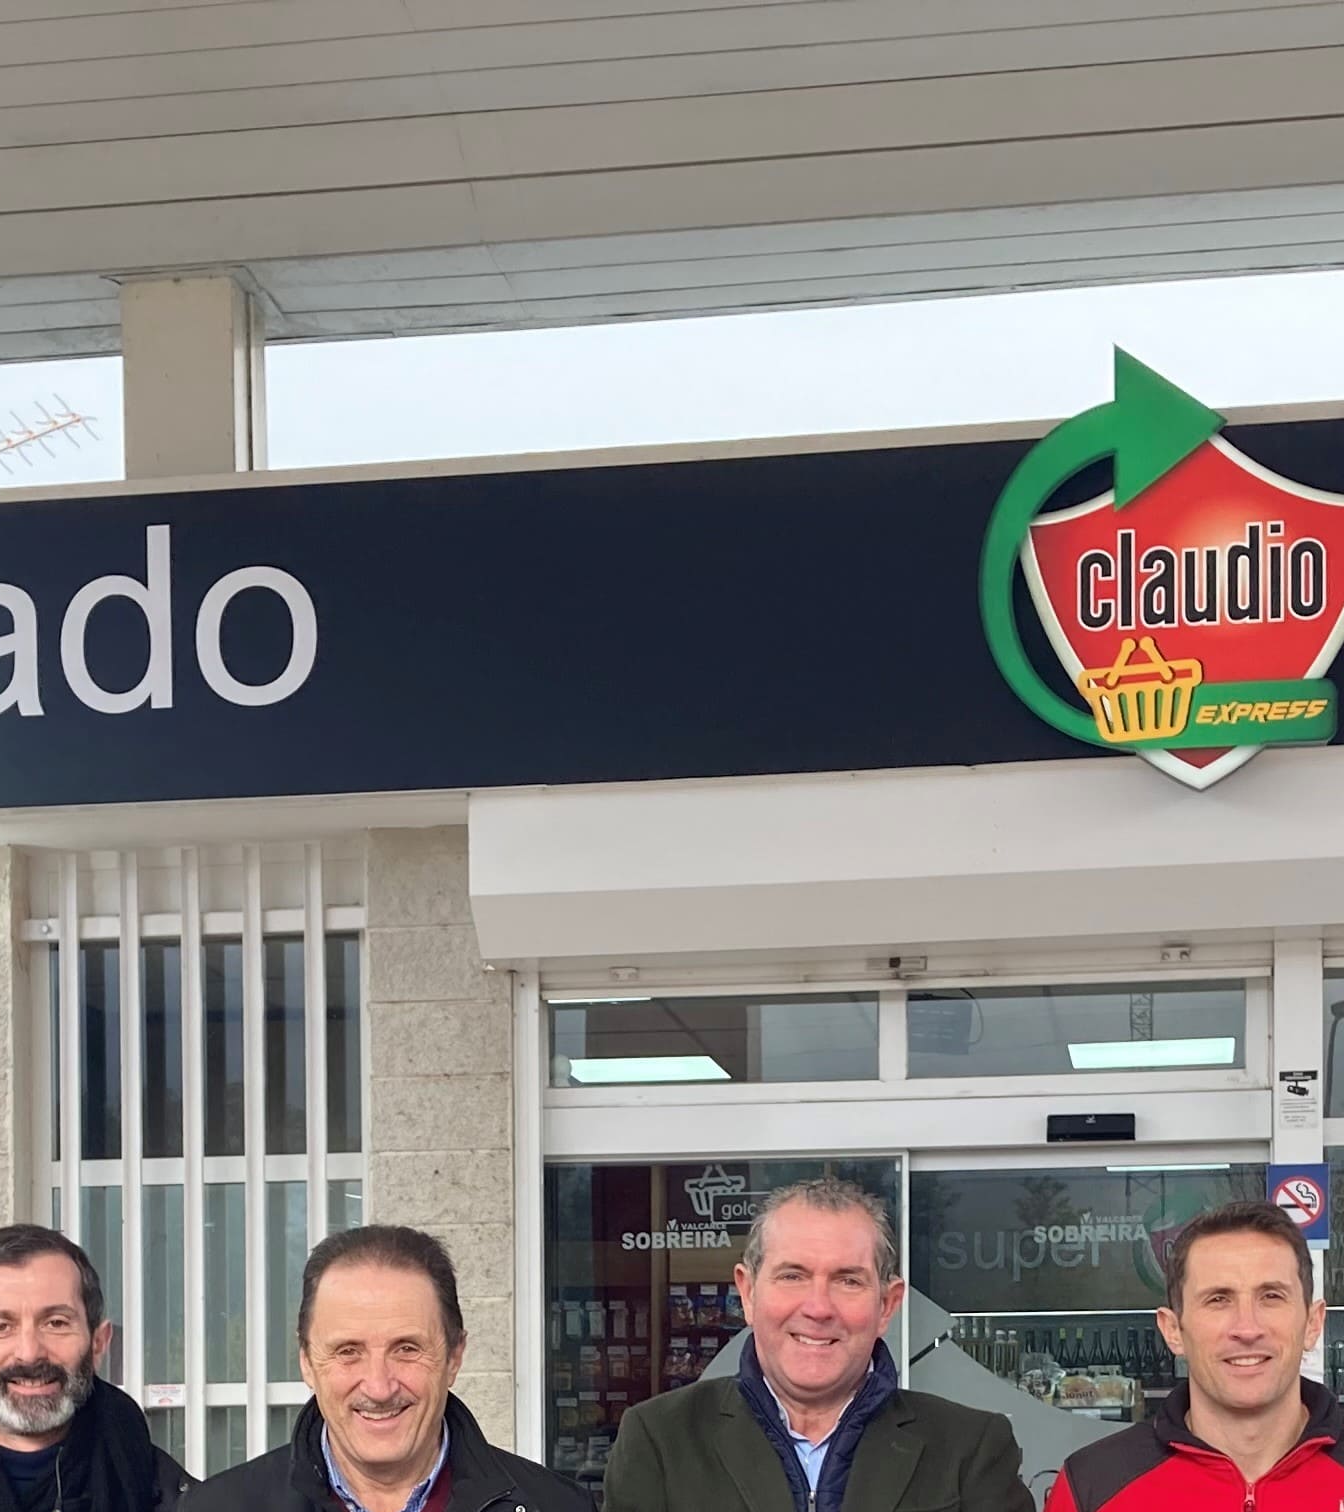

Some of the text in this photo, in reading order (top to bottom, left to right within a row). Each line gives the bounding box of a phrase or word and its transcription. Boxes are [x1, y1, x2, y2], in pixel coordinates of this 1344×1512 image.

[1076, 520, 1325, 632] claudio
[1195, 699, 1328, 725] EXPRESS
[621, 1230, 732, 1250] SOBREIRA
[1033, 1223, 1149, 1244] SOBREIRA
